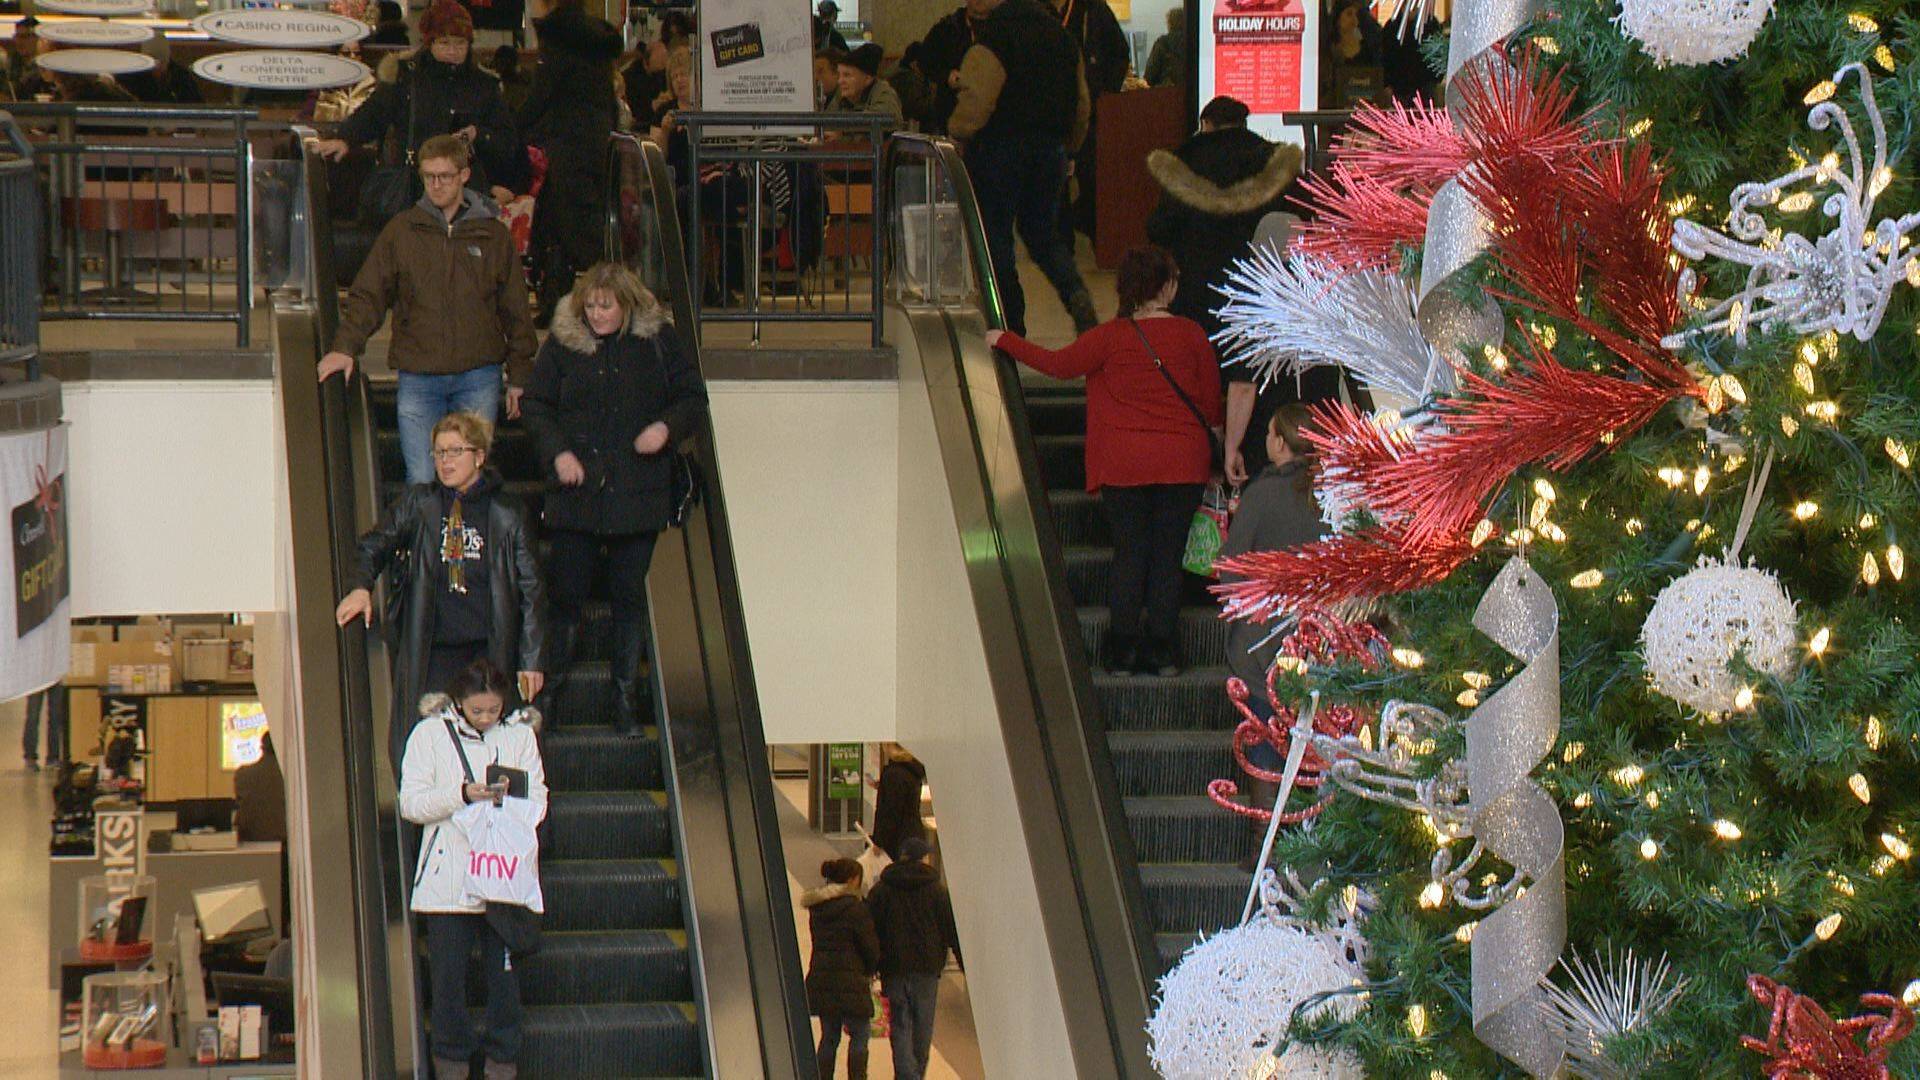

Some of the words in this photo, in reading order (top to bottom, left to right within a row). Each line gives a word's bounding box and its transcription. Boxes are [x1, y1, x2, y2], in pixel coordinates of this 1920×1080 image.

[224, 20, 281, 31] CASINO
[286, 22, 342, 33] REGINA
[1218, 17, 1264, 31] HOLIDAY
[1265, 16, 1300, 31] HOURS
[737, 42, 759, 56] CARD
[263, 55, 303, 64] DELTA
[240, 64, 326, 74] CONFERENCE
[258, 75, 309, 83] CENTRE
